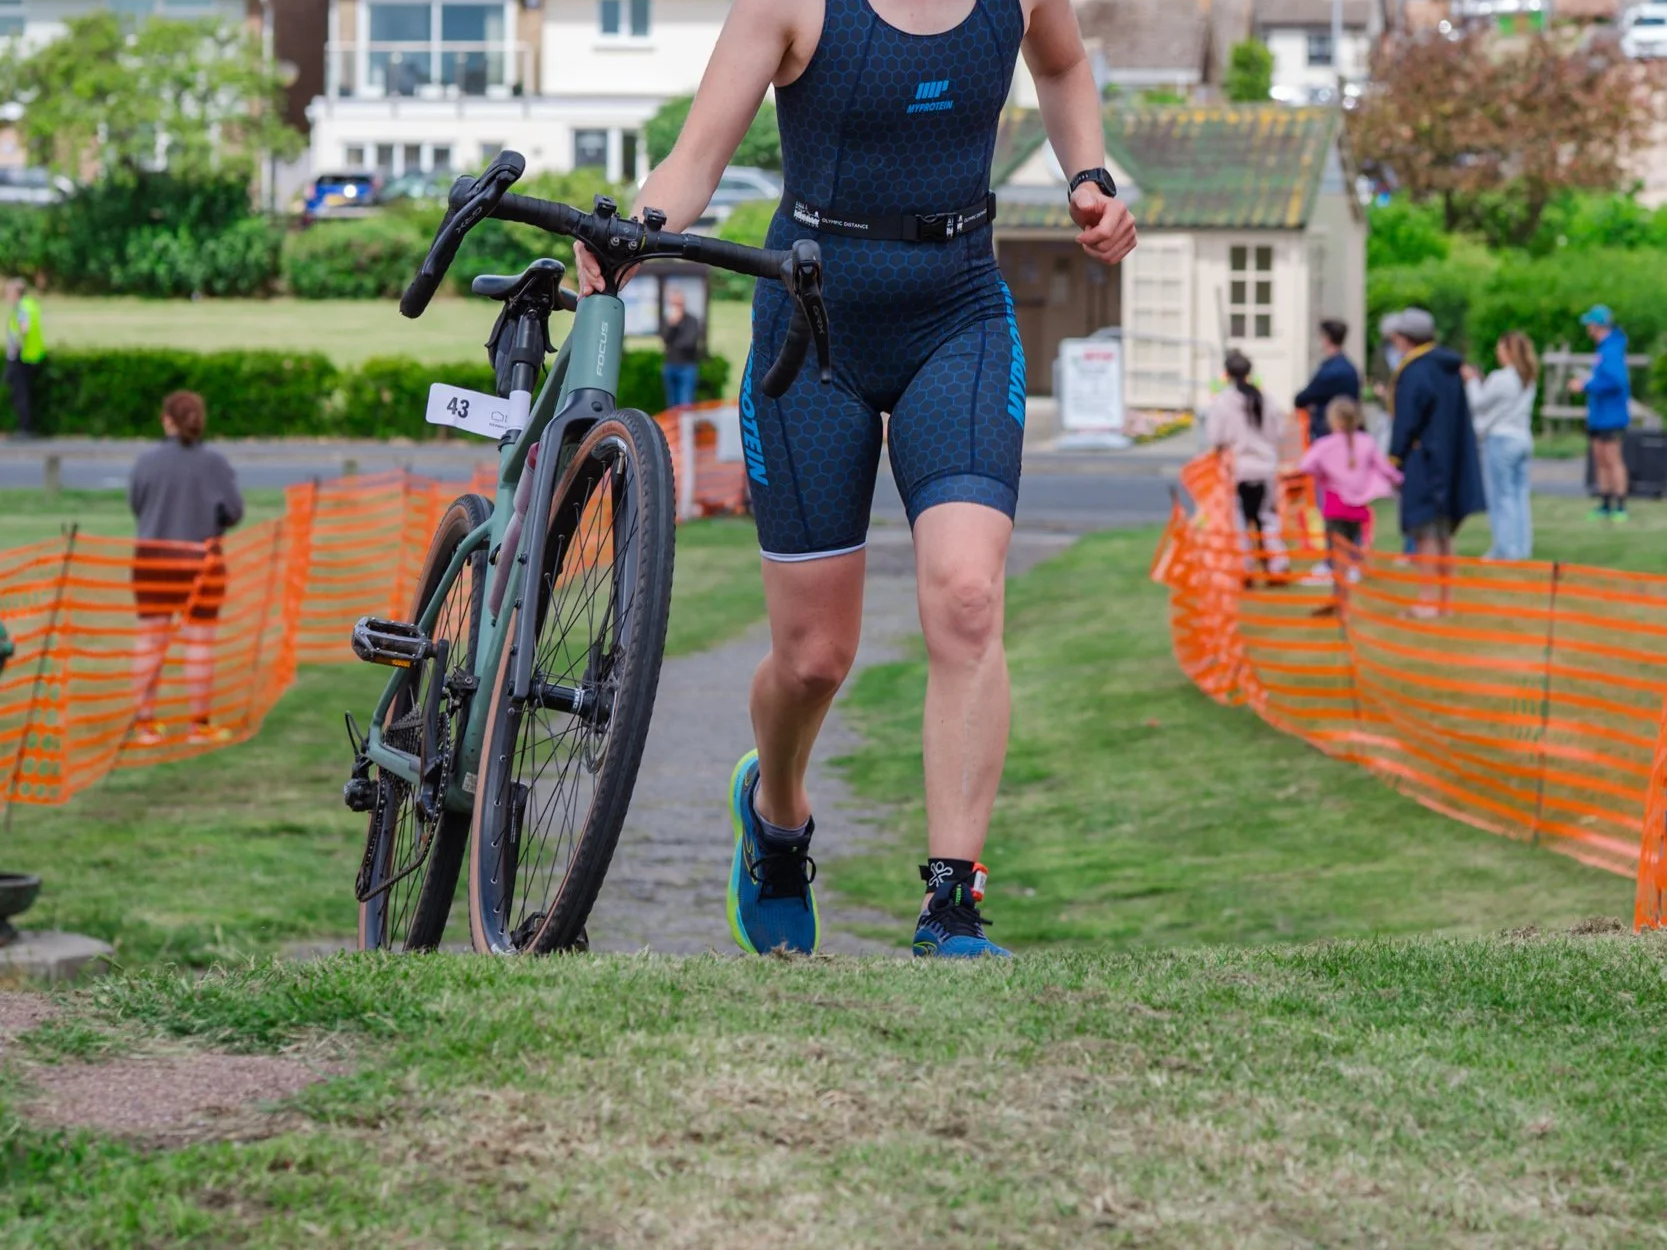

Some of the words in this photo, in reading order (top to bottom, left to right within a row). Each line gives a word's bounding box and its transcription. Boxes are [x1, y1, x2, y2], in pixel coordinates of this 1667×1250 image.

[906, 100, 954, 114] MYPROTEIN
[821, 217, 844, 226] OLYMPIC
[843, 221, 869, 230] DISTANCE
[596, 321, 609, 377] FOCUS
[446, 397, 470, 419] 43
